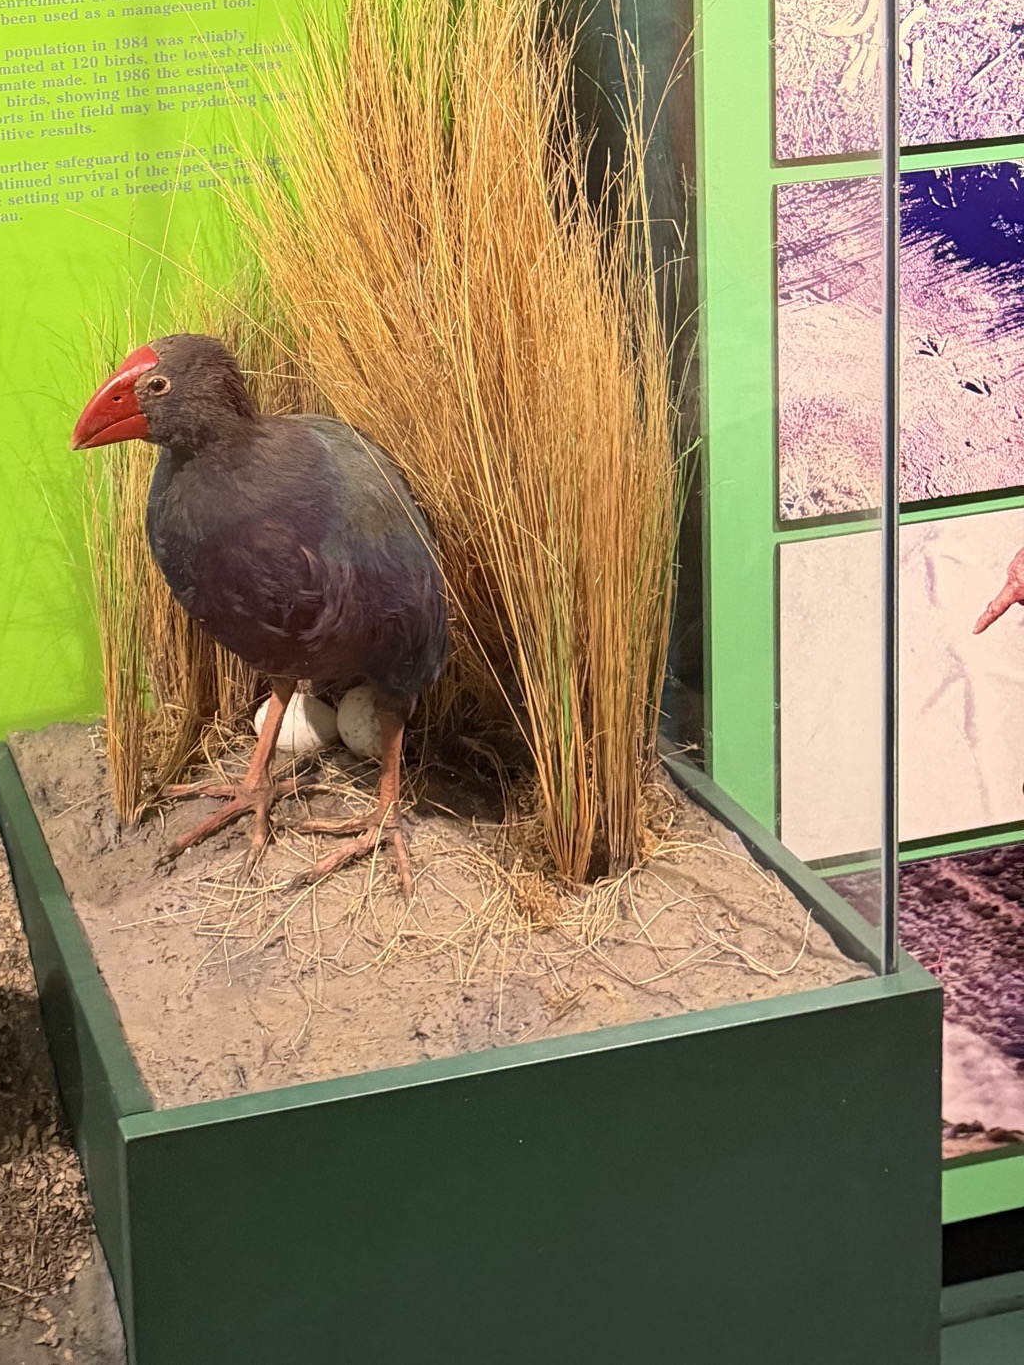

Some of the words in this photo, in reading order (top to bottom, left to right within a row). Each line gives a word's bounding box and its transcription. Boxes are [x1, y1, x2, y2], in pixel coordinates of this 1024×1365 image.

[0, 13, 36, 25] been
[43, 7, 78, 22] used
[84, 9, 101, 19] as
[106, 8, 115, 17] a
[40, 122, 96, 137] results.
